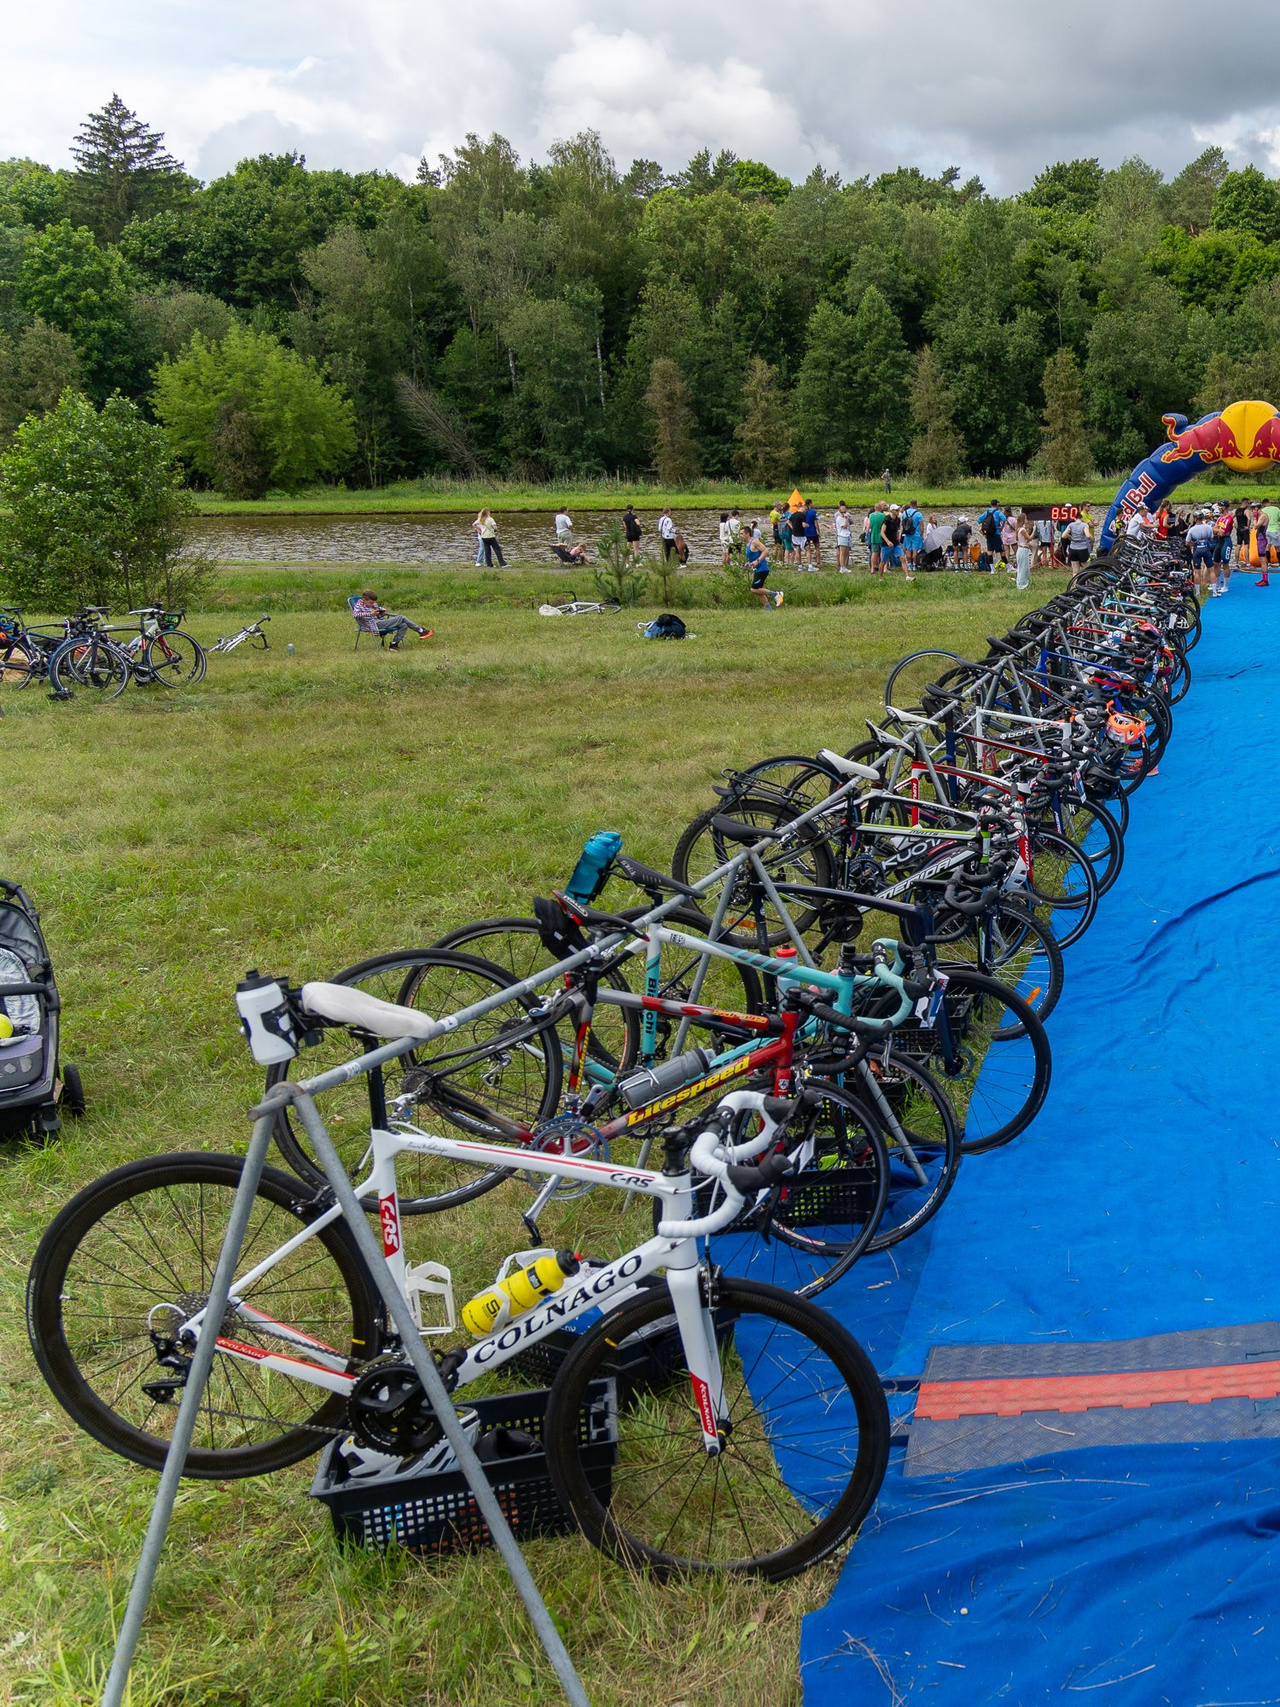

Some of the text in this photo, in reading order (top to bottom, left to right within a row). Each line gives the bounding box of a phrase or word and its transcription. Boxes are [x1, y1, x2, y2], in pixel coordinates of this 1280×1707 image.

[1126, 472, 1157, 506] Bull
[645, 978, 657, 1035] Bichi
[627, 1056, 750, 1127] Litespeed
[610, 1173, 654, 1188] C-RS
[381, 1200, 399, 1249] C-RS
[474, 1255, 642, 1364] COLNAGO
[222, 1340, 266, 1359] COLNAGO
[701, 1388, 713, 1434] COLNAGO
